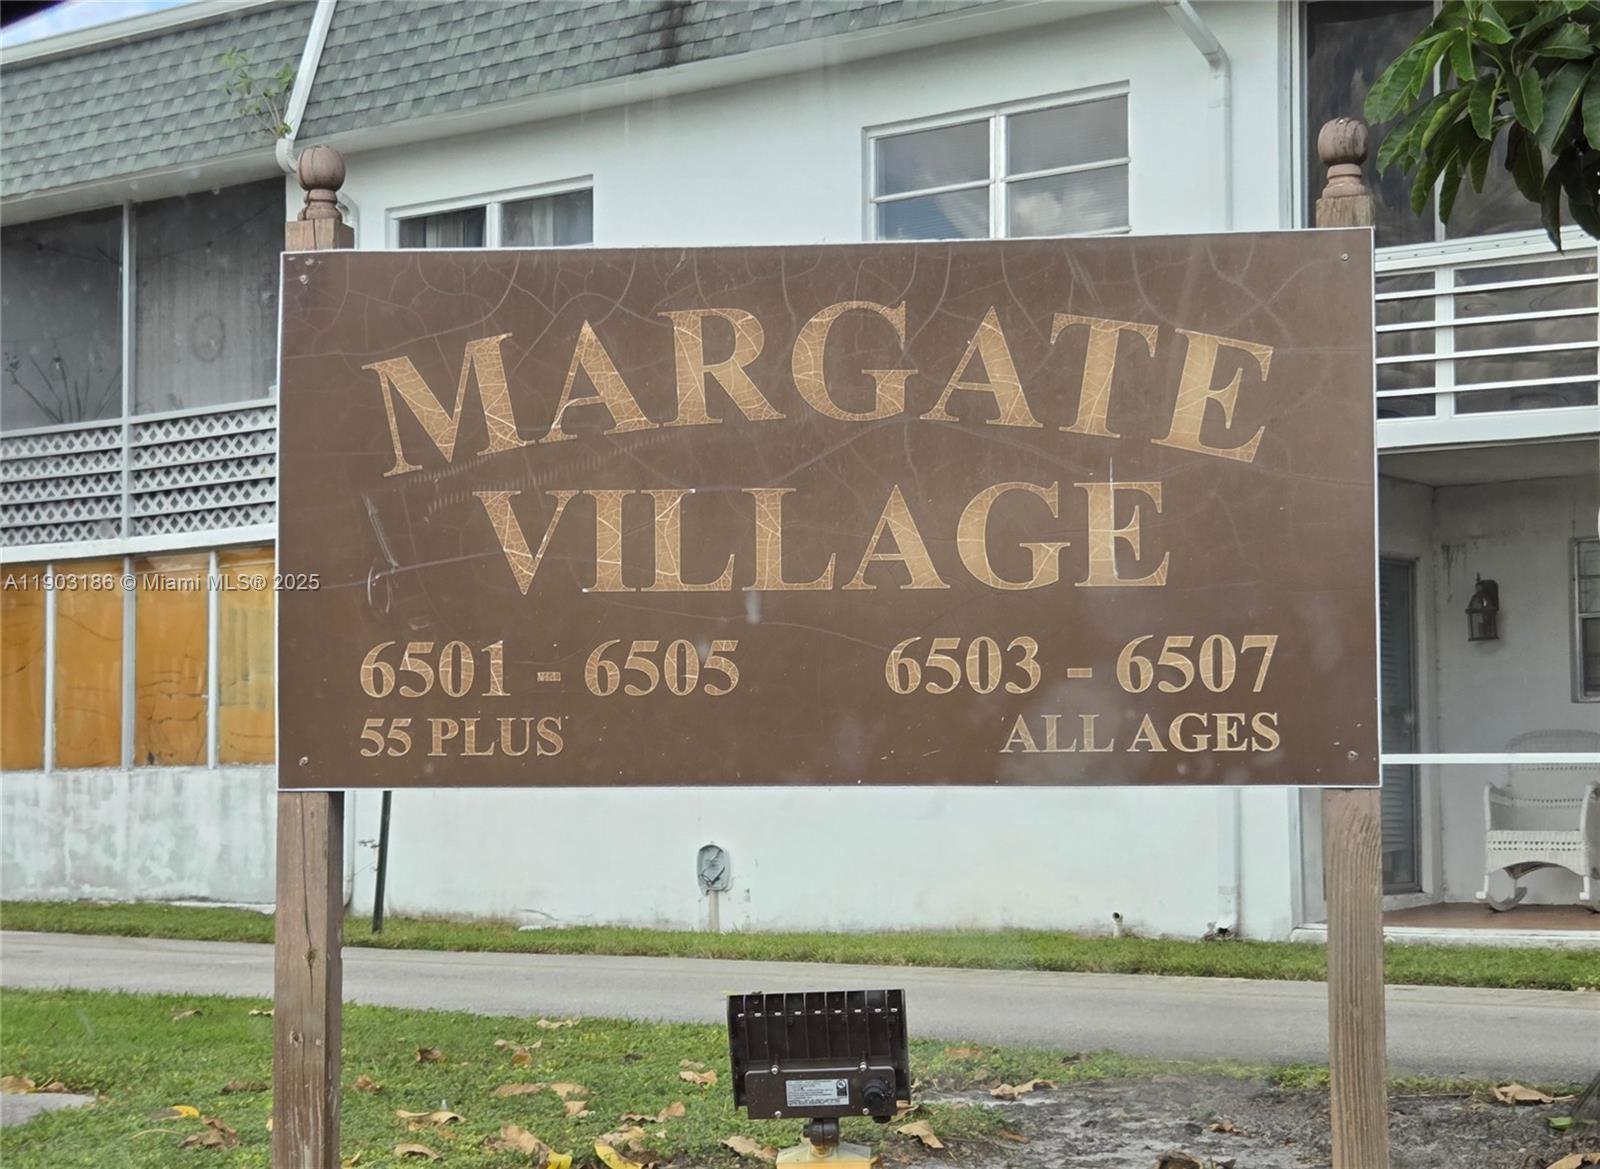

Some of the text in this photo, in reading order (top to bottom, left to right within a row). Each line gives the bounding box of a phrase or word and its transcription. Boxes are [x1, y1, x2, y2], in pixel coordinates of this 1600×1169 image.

[361, 300, 1274, 477] MARGATE
[473, 480, 1170, 595] VILLAGE
[359, 639, 740, 699] 6501 - 6505
[885, 634, 1279, 695] 6503 - 6507
[359, 716, 564, 757] 55 PLUS
[1000, 712, 1281, 753] ALL AGES
